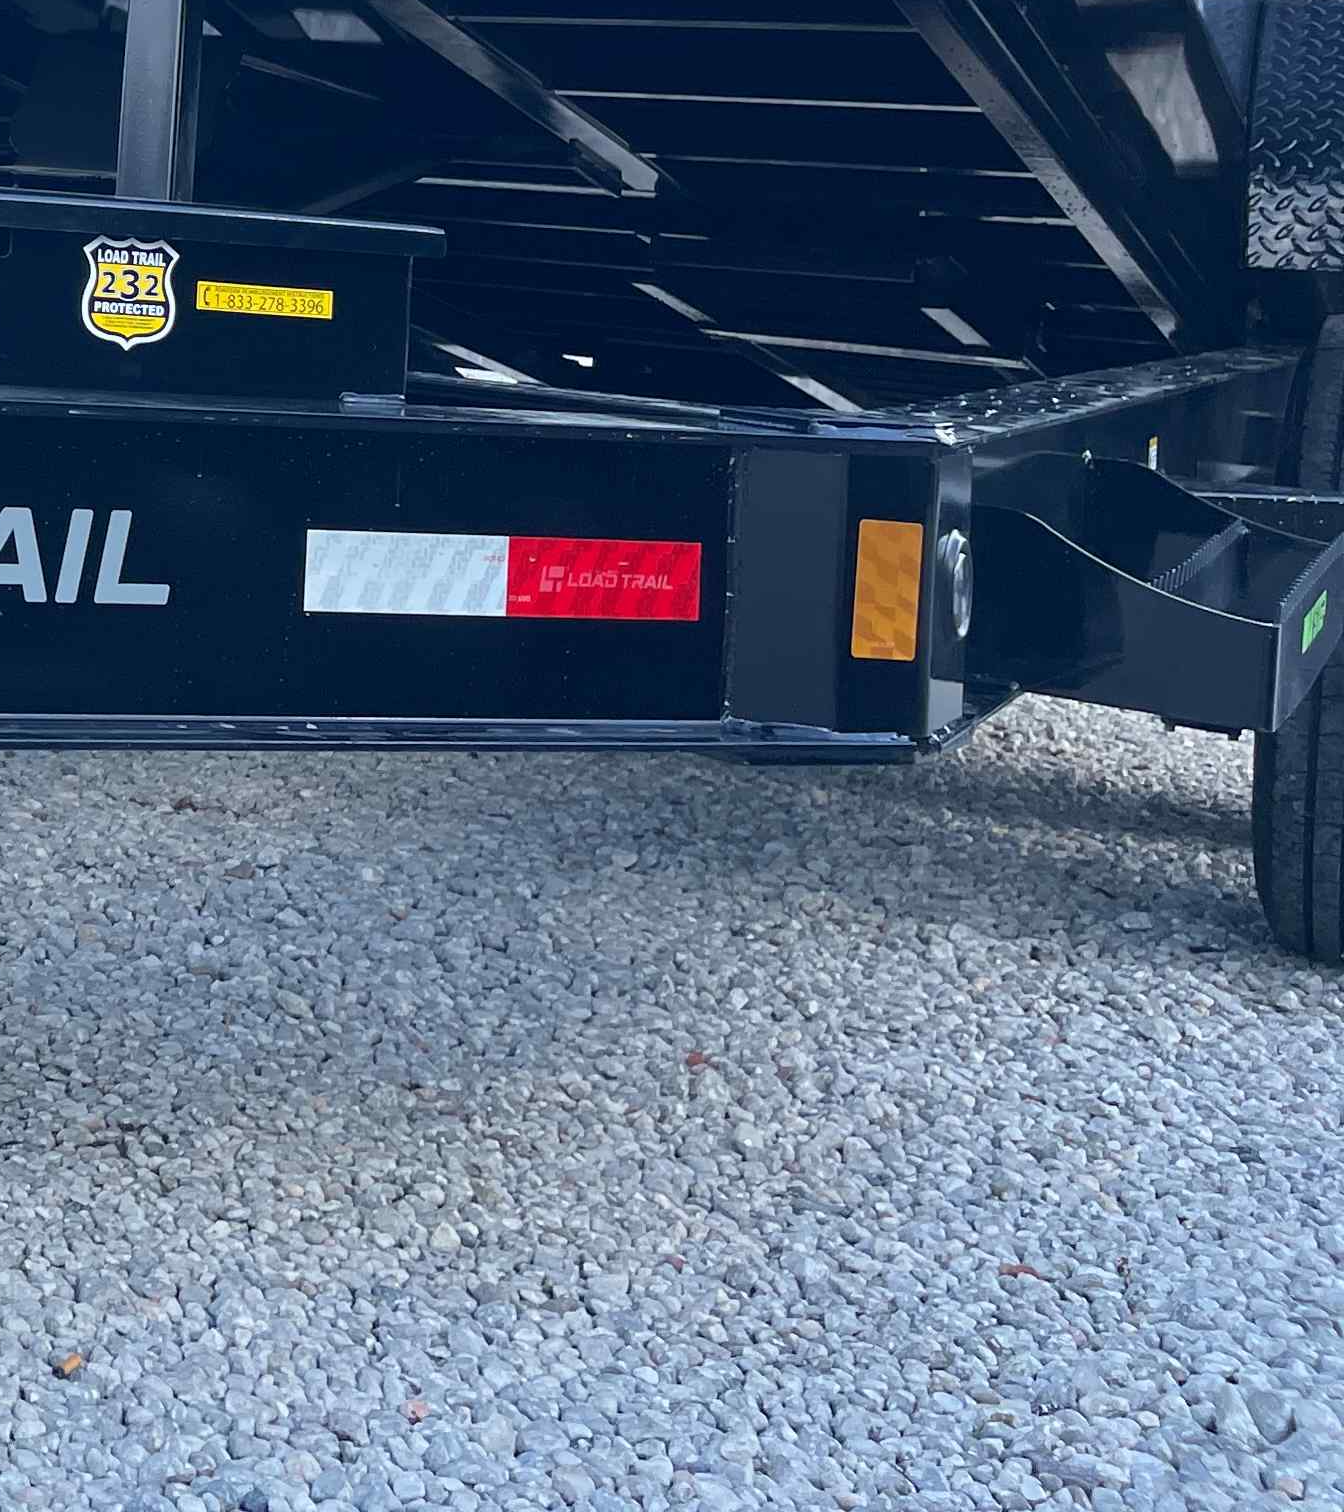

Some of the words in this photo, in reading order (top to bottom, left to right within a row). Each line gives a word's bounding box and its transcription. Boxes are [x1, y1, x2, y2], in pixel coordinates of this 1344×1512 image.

[97, 248, 129, 264] LOAD
[132, 251, 166, 267] TRAIL
[102, 269, 159, 299] 232
[93, 300, 165, 316] PROTECTED
[215, 293, 324, 314] 1-833-278-3396
[567, 572, 618, 588] LOAD
[621, 574, 673, 590] TRAIL
